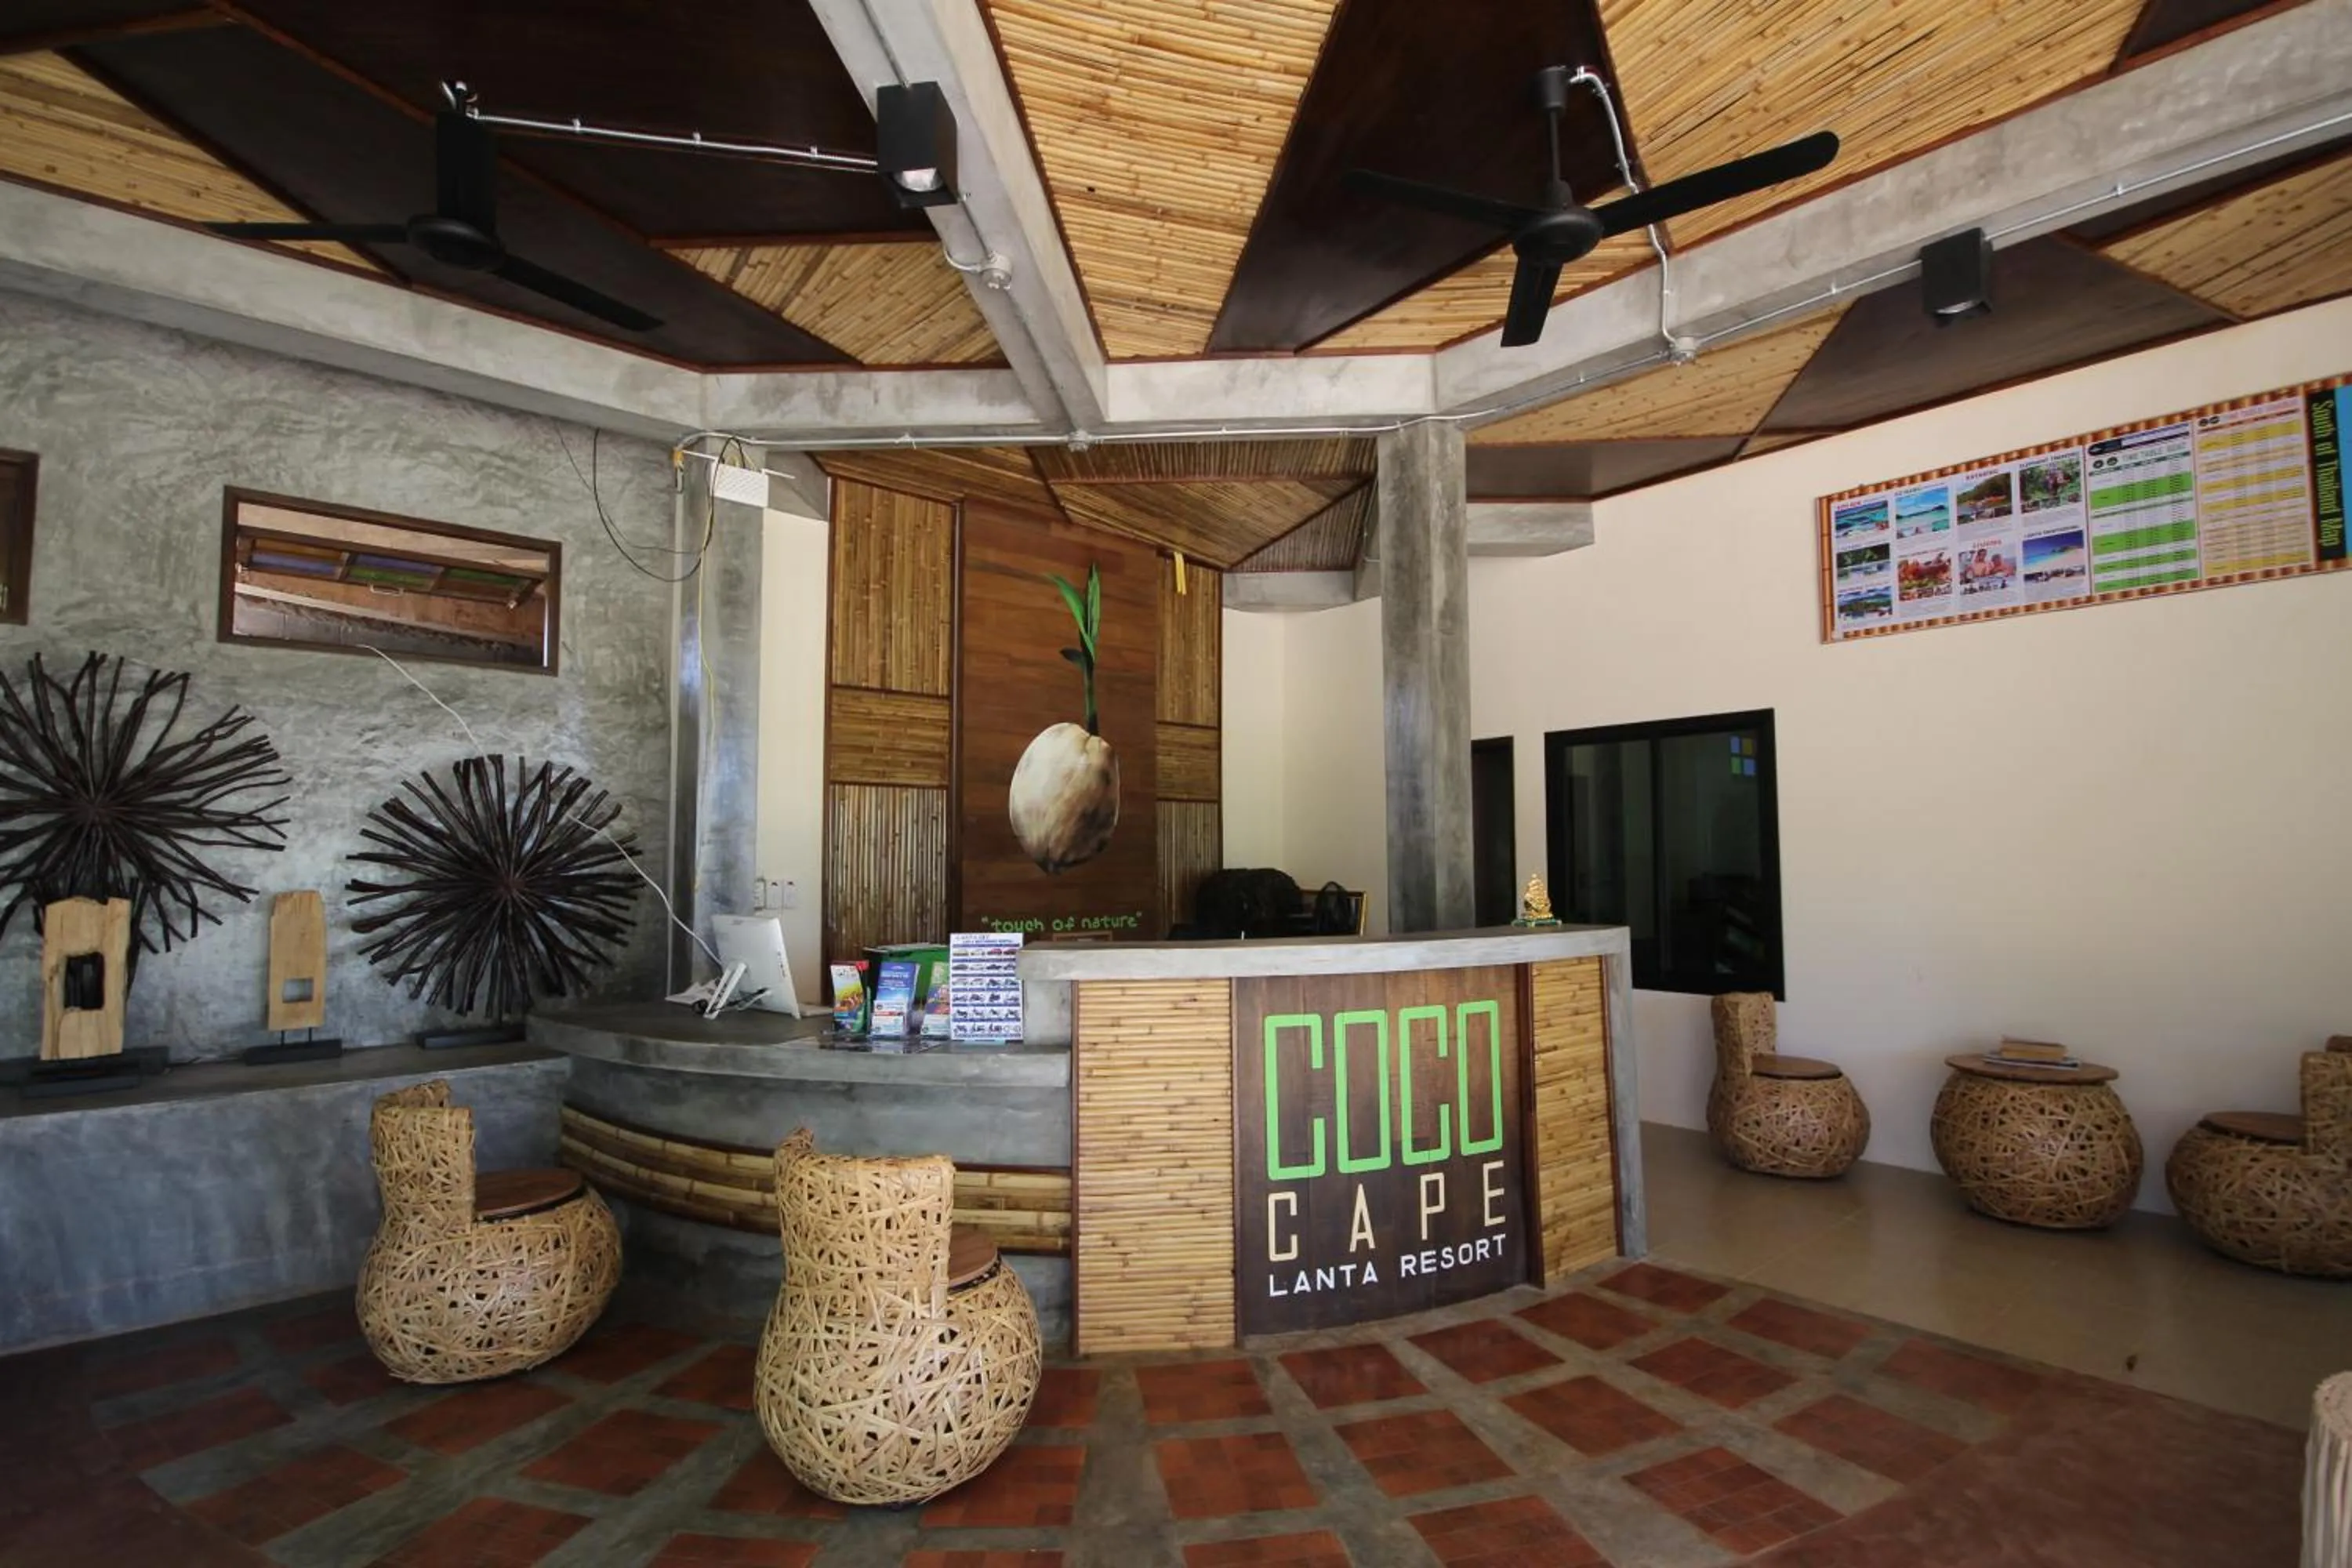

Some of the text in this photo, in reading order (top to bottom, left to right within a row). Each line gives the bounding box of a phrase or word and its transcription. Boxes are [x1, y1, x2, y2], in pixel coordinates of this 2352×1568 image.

[2312, 400, 2343, 547] South of Thailand Map
[1052, 916, 1075, 931] of
[1264, 1000, 1504, 1181] COCO
[1268, 1160, 1506, 1261] CAPE
[1269, 1233, 1506, 1298] LANTA RESORT
